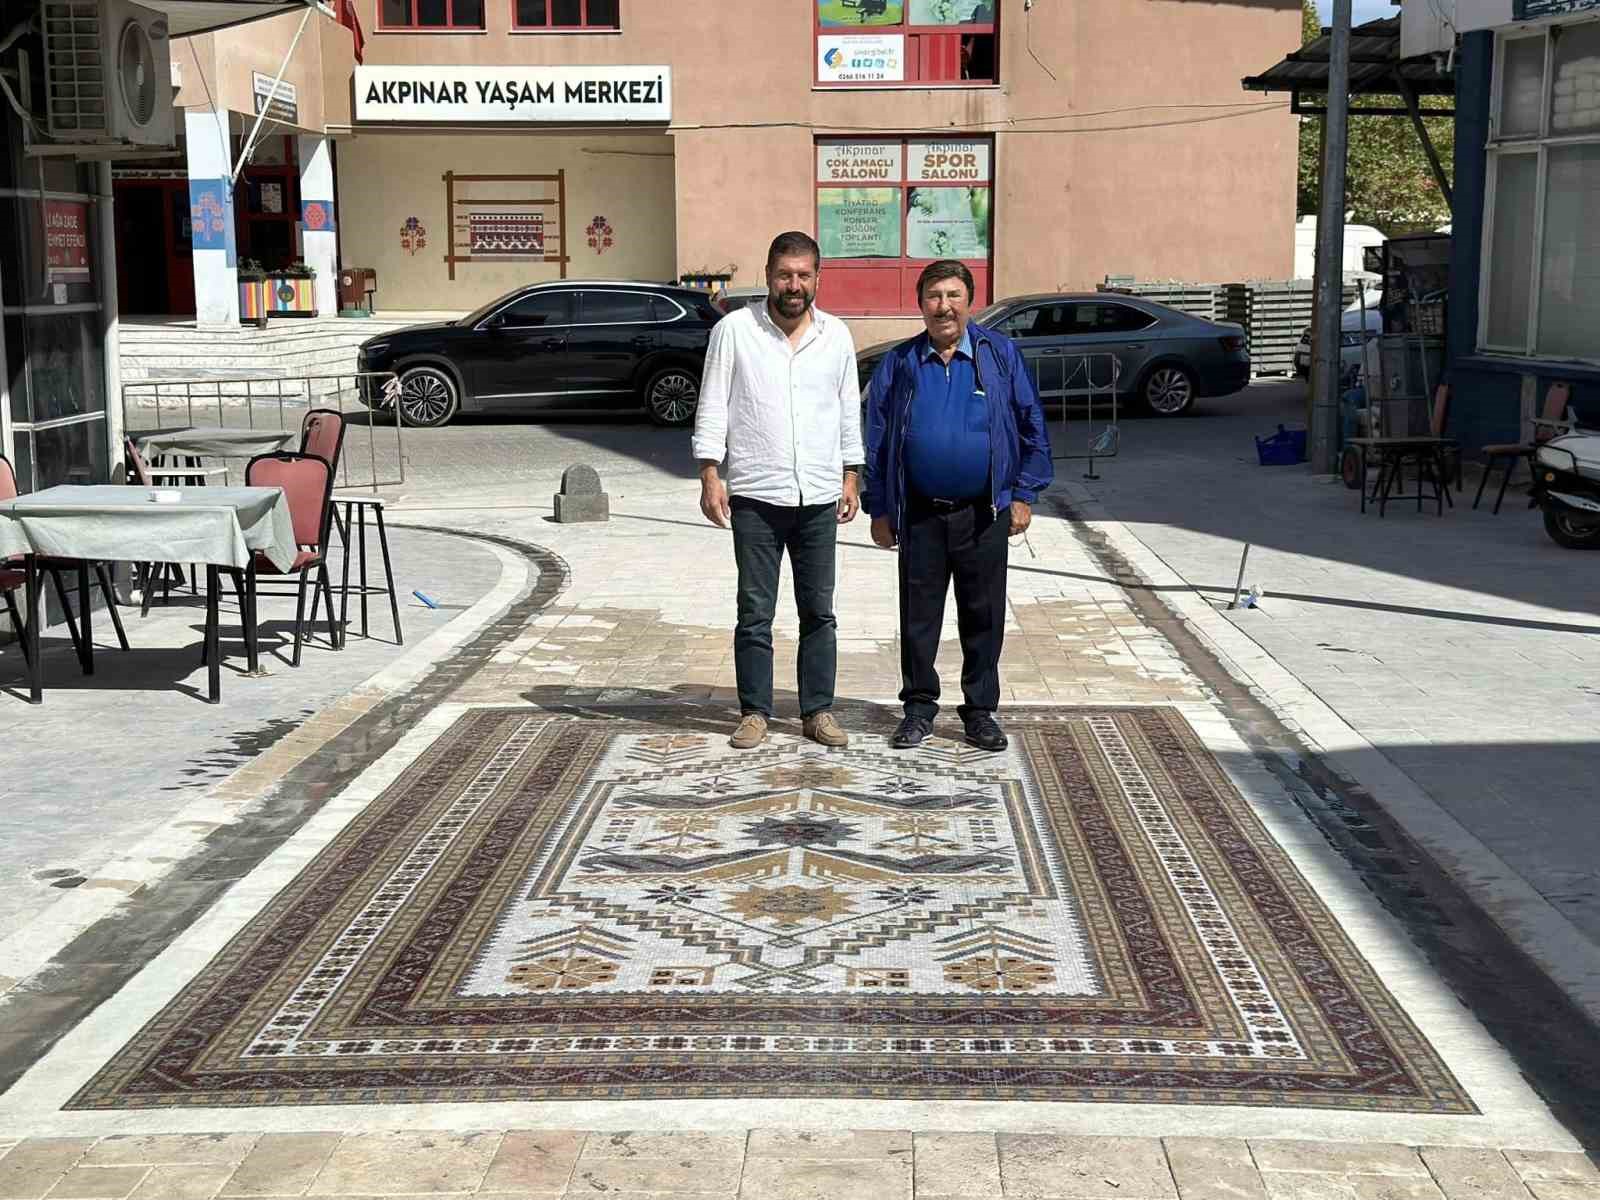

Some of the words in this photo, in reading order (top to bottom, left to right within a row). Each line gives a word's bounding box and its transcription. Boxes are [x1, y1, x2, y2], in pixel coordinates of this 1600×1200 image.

[365, 80, 469, 104] AKPINAR
[475, 80, 555, 110] YAŞAM
[564, 75, 663, 104] MERKEZİ
[826, 159, 852, 168] ÇOK
[852, 159, 894, 168] AMAÇLI
[923, 154, 977, 168] SPOR
[831, 168, 889, 179] SALONU
[921, 169, 979, 179] SALONU
[836, 208, 887, 216] KONFERANS
[843, 216, 879, 224] KONSER
[47, 233, 65, 247] EHMET
